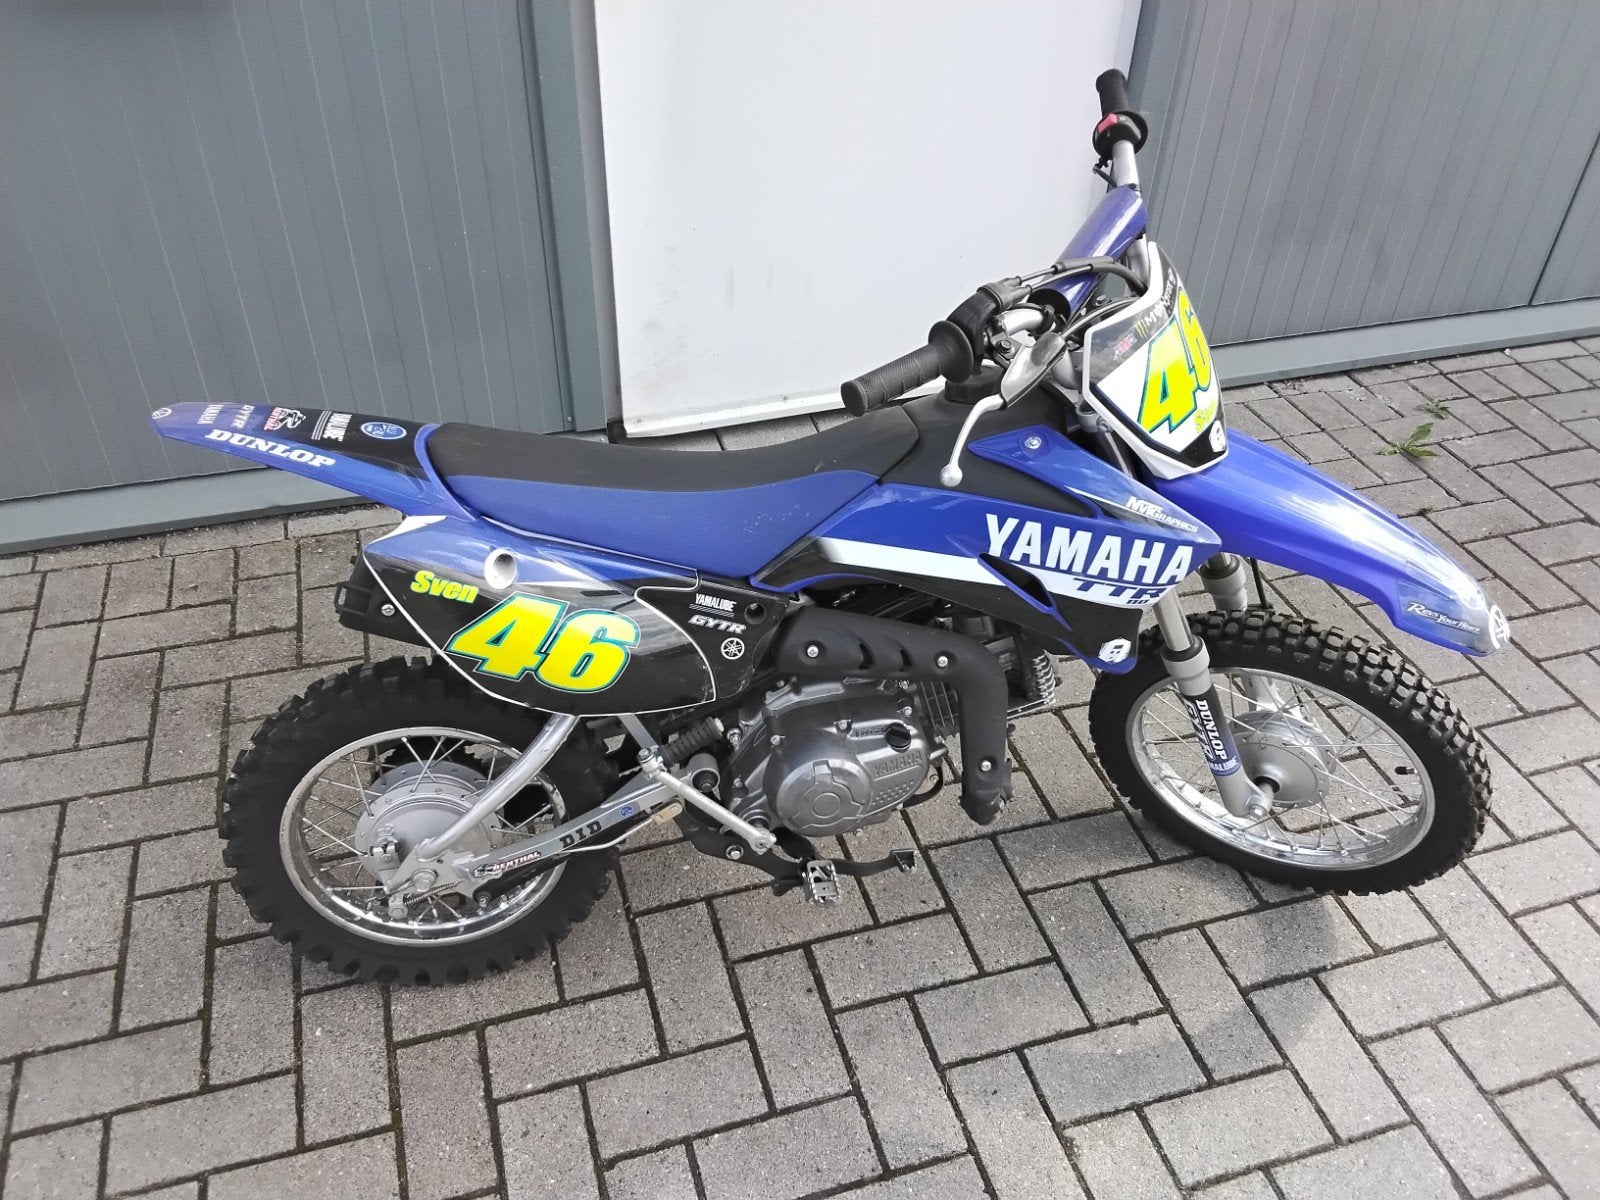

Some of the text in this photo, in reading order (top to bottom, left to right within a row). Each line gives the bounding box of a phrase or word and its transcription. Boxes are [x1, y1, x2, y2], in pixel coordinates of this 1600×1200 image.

[1137, 288, 1211, 433] 46
[204, 429, 336, 468] DUNLOP
[986, 513, 1193, 586] YAMAHA
[410, 569, 479, 604] Sven
[695, 593, 737, 612] YAMALUBE
[1073, 577, 1168, 599] TTR
[442, 590, 641, 694] 46
[688, 614, 747, 634] GYTR
[1195, 699, 1227, 760] DUNLOP
[873, 751, 922, 777] YAMAHA
